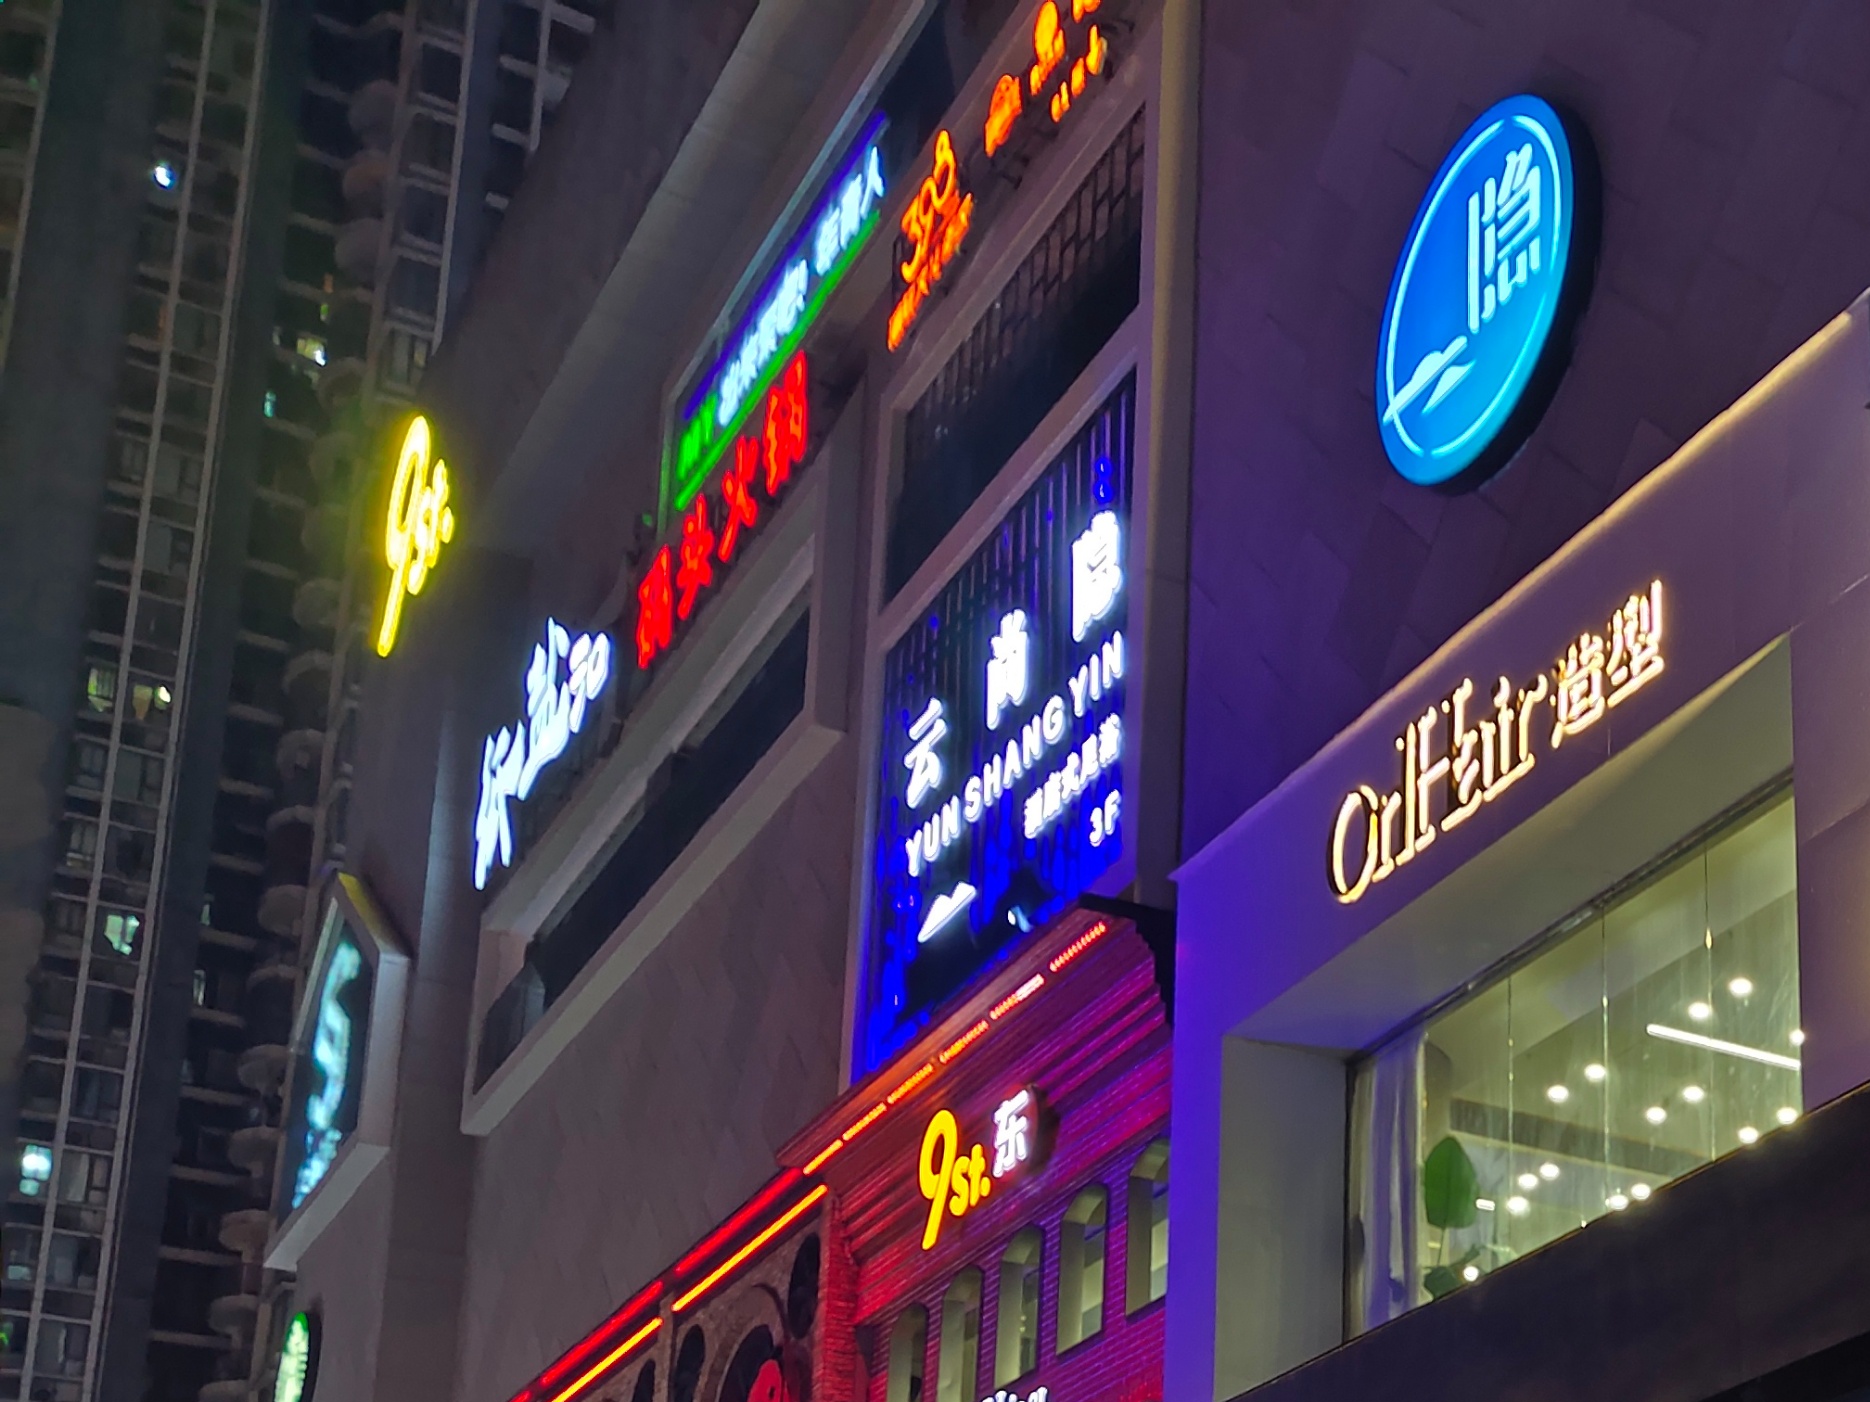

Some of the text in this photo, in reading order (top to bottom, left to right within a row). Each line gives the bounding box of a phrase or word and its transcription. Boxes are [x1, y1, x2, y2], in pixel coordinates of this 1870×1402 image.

[1466, 142, 1544, 333] 隐
[905, 630, 1123, 878] YUN SHANG YIN
[1549, 579, 1666, 750] 造型
[1089, 790, 1121, 847] 3F
